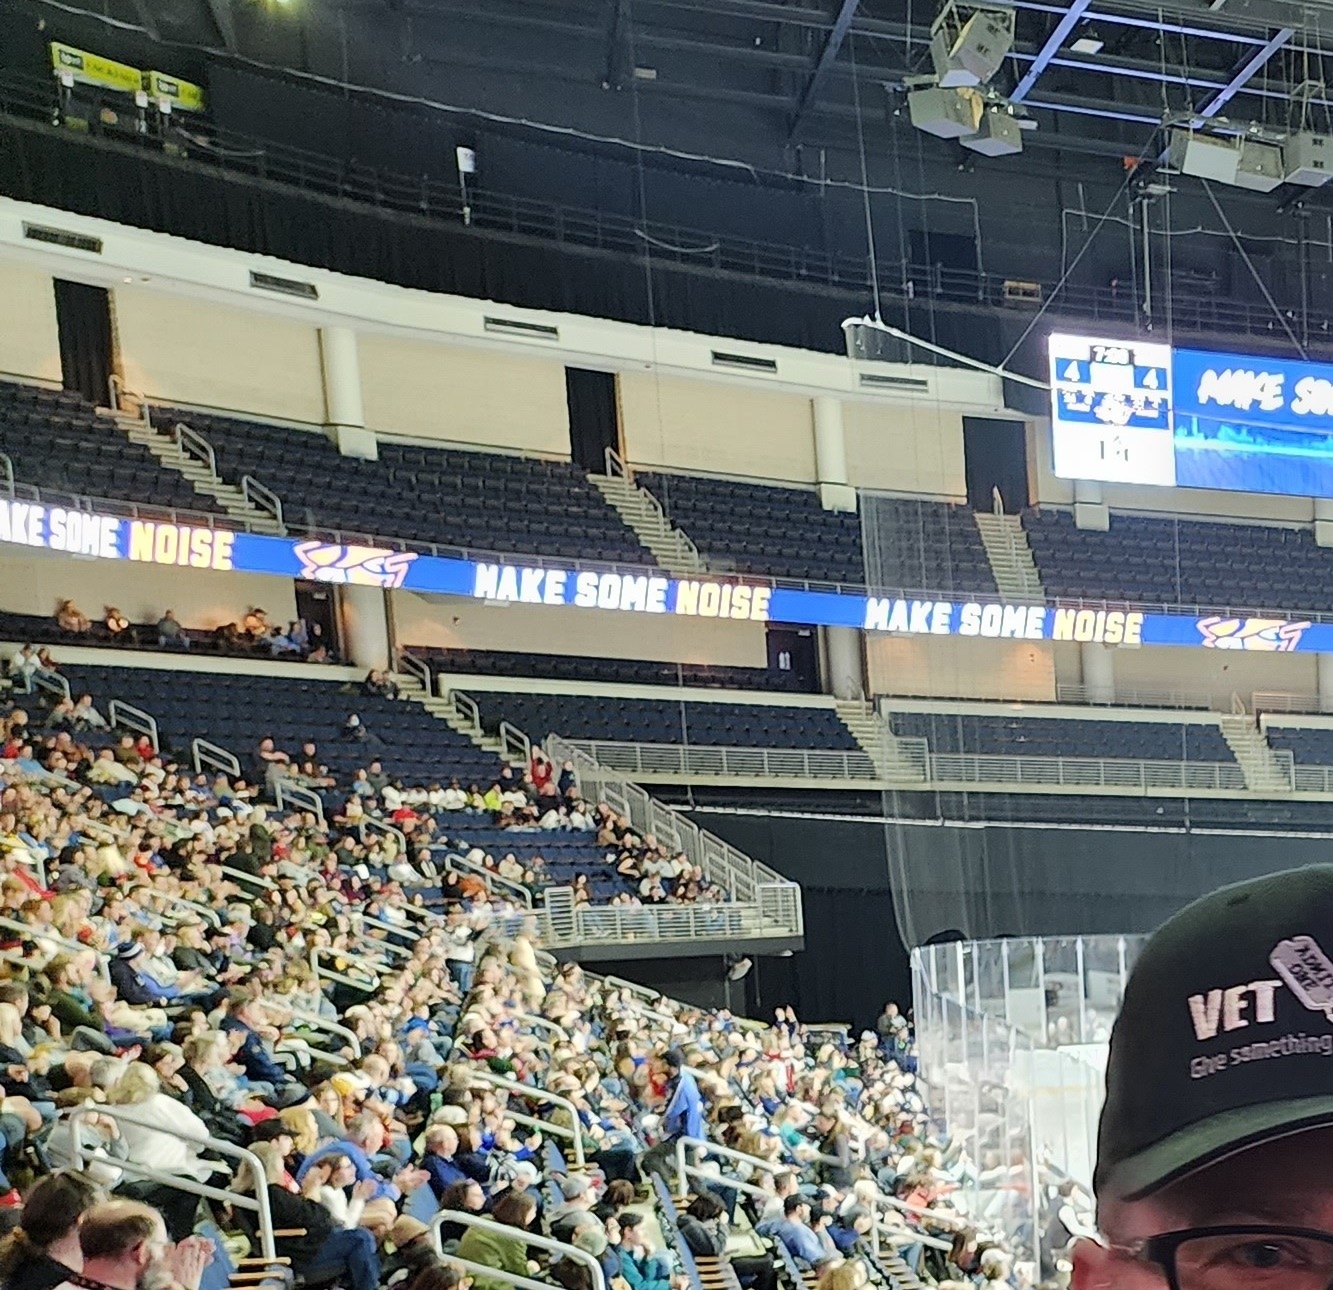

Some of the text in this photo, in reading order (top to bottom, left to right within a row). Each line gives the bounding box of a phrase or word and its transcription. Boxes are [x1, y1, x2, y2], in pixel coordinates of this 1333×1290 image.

[1063, 360, 1081, 382] 4
[1142, 368, 1159, 390] 4
[1197, 368, 1284, 411] MAKE
[49, 507, 120, 559] SOME
[128, 521, 235, 570] NOISE
[474, 563, 771, 621] MAKE SOME NOISE
[864, 597, 1143, 645] MAKE SOME NOISE
[1187, 979, 1283, 1041] VET
[1230, 1032, 1333, 1065] something
